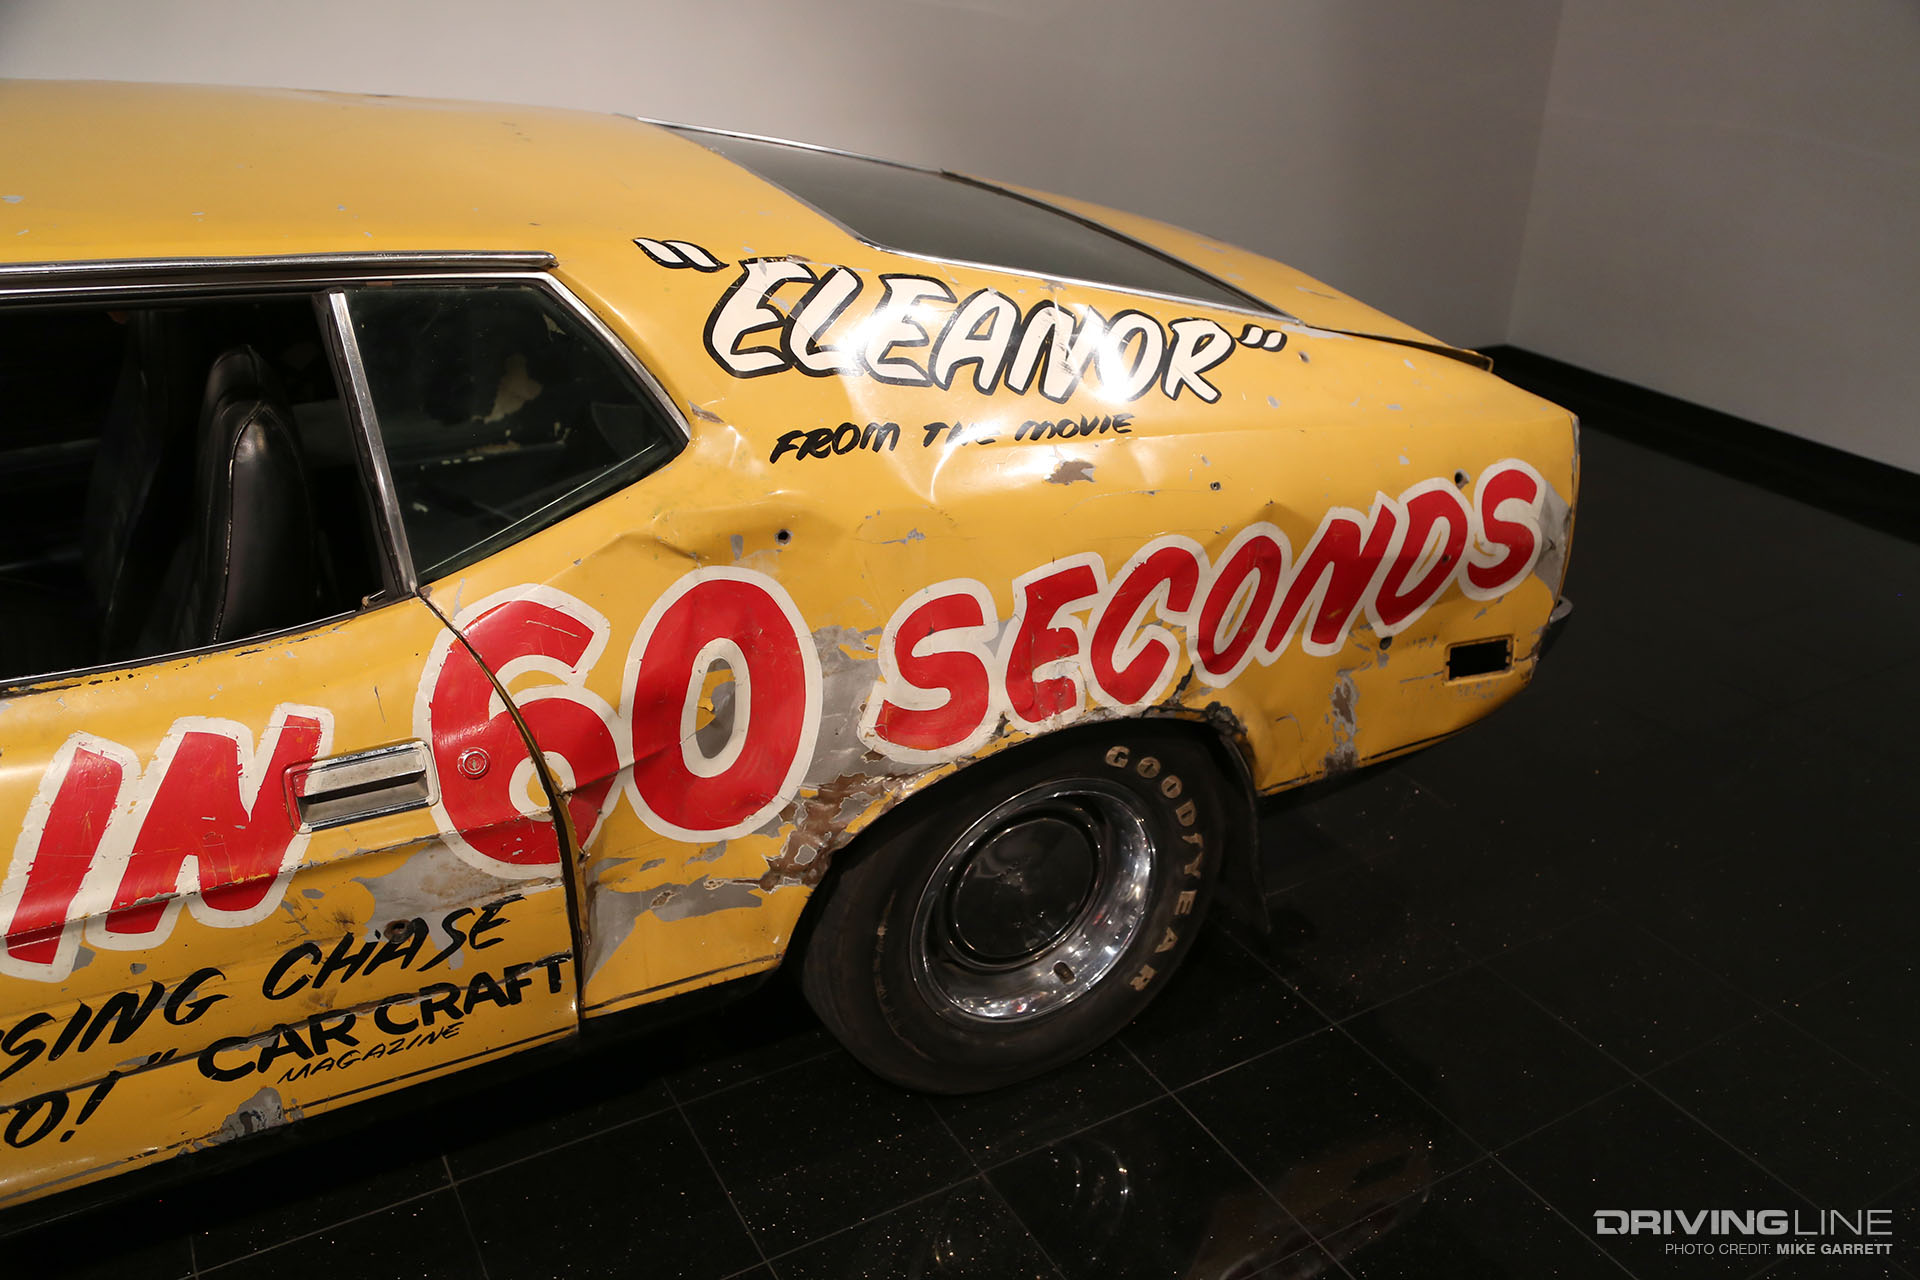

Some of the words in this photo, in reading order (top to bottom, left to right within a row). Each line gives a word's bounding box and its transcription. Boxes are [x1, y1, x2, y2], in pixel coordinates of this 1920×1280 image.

[769, 422, 900, 464] FROM
[1013, 413, 1135, 442] MOVIE
[0, 702, 335, 983] IN
[412, 565, 824, 881] 60
[857, 457, 1547, 764] SECONDS
[1105, 745, 1204, 992] GOODYEAR
[0, 967, 229, 1082] SING
[261, 896, 527, 1001] CHASE
[197, 1010, 360, 1082] CAR
[374, 952, 573, 1035] CRAFT
[277, 1022, 464, 1084] MAGAZINE
